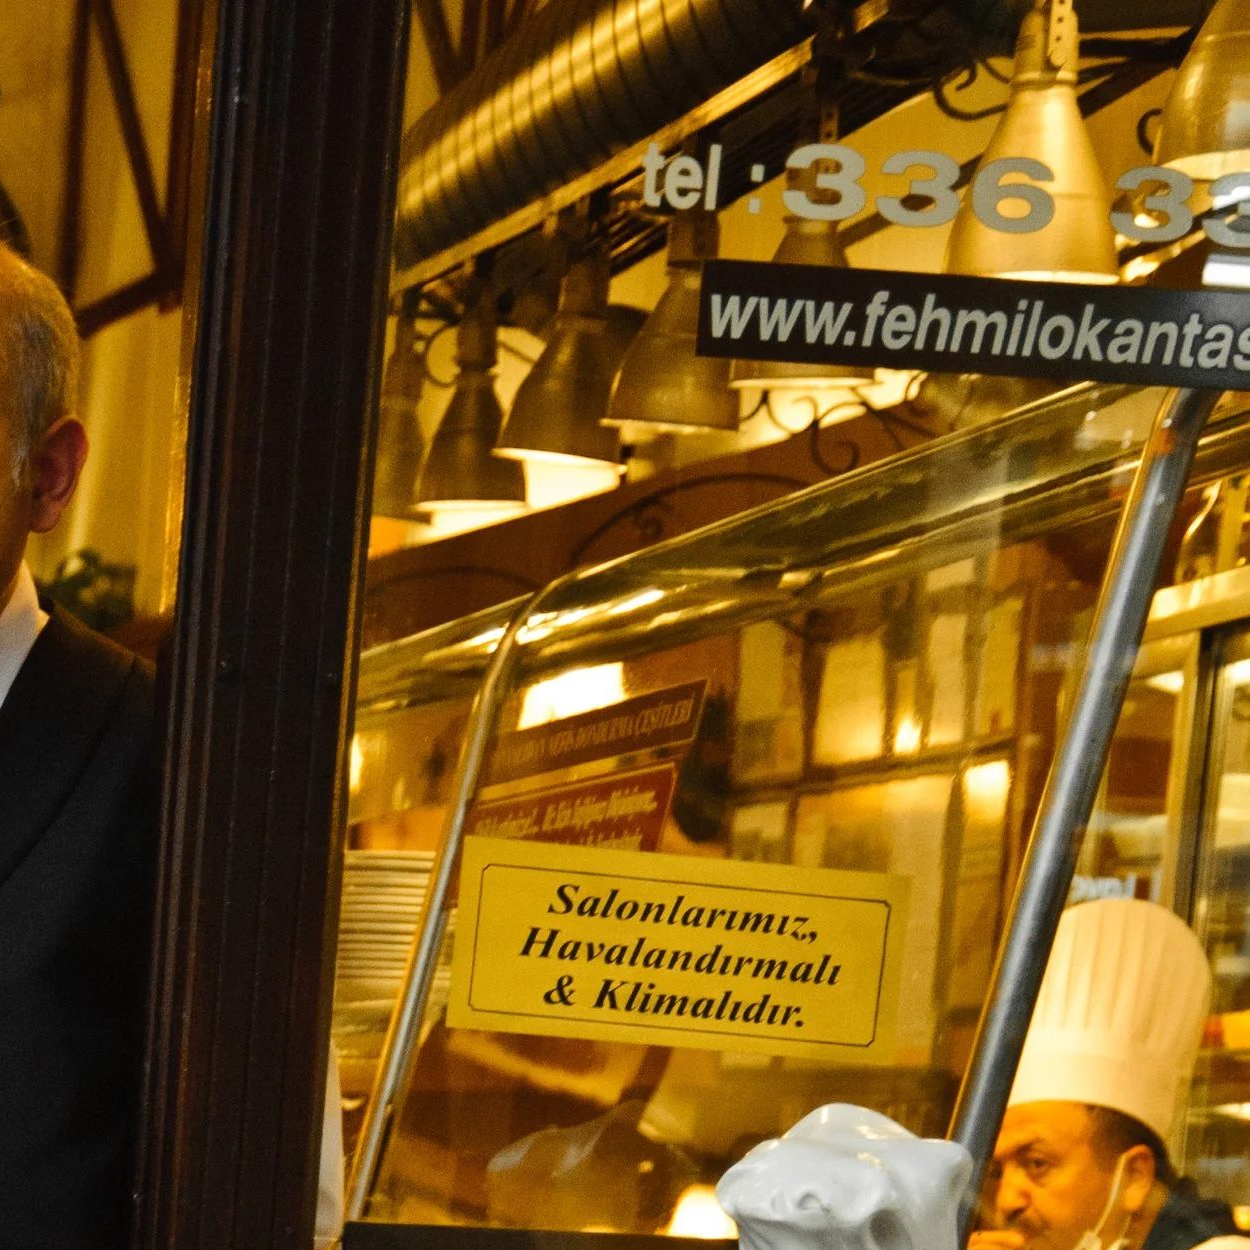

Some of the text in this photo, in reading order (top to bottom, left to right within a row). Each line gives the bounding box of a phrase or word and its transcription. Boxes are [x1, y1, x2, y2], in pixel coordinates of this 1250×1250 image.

[643, 143, 721, 212] tel
[781, 143, 1056, 234] 336
[546, 883, 819, 945] Salonlarımız,
[518, 926, 843, 986] Havalandırmalı
[543, 974, 805, 1029] & Klimalıdır.
